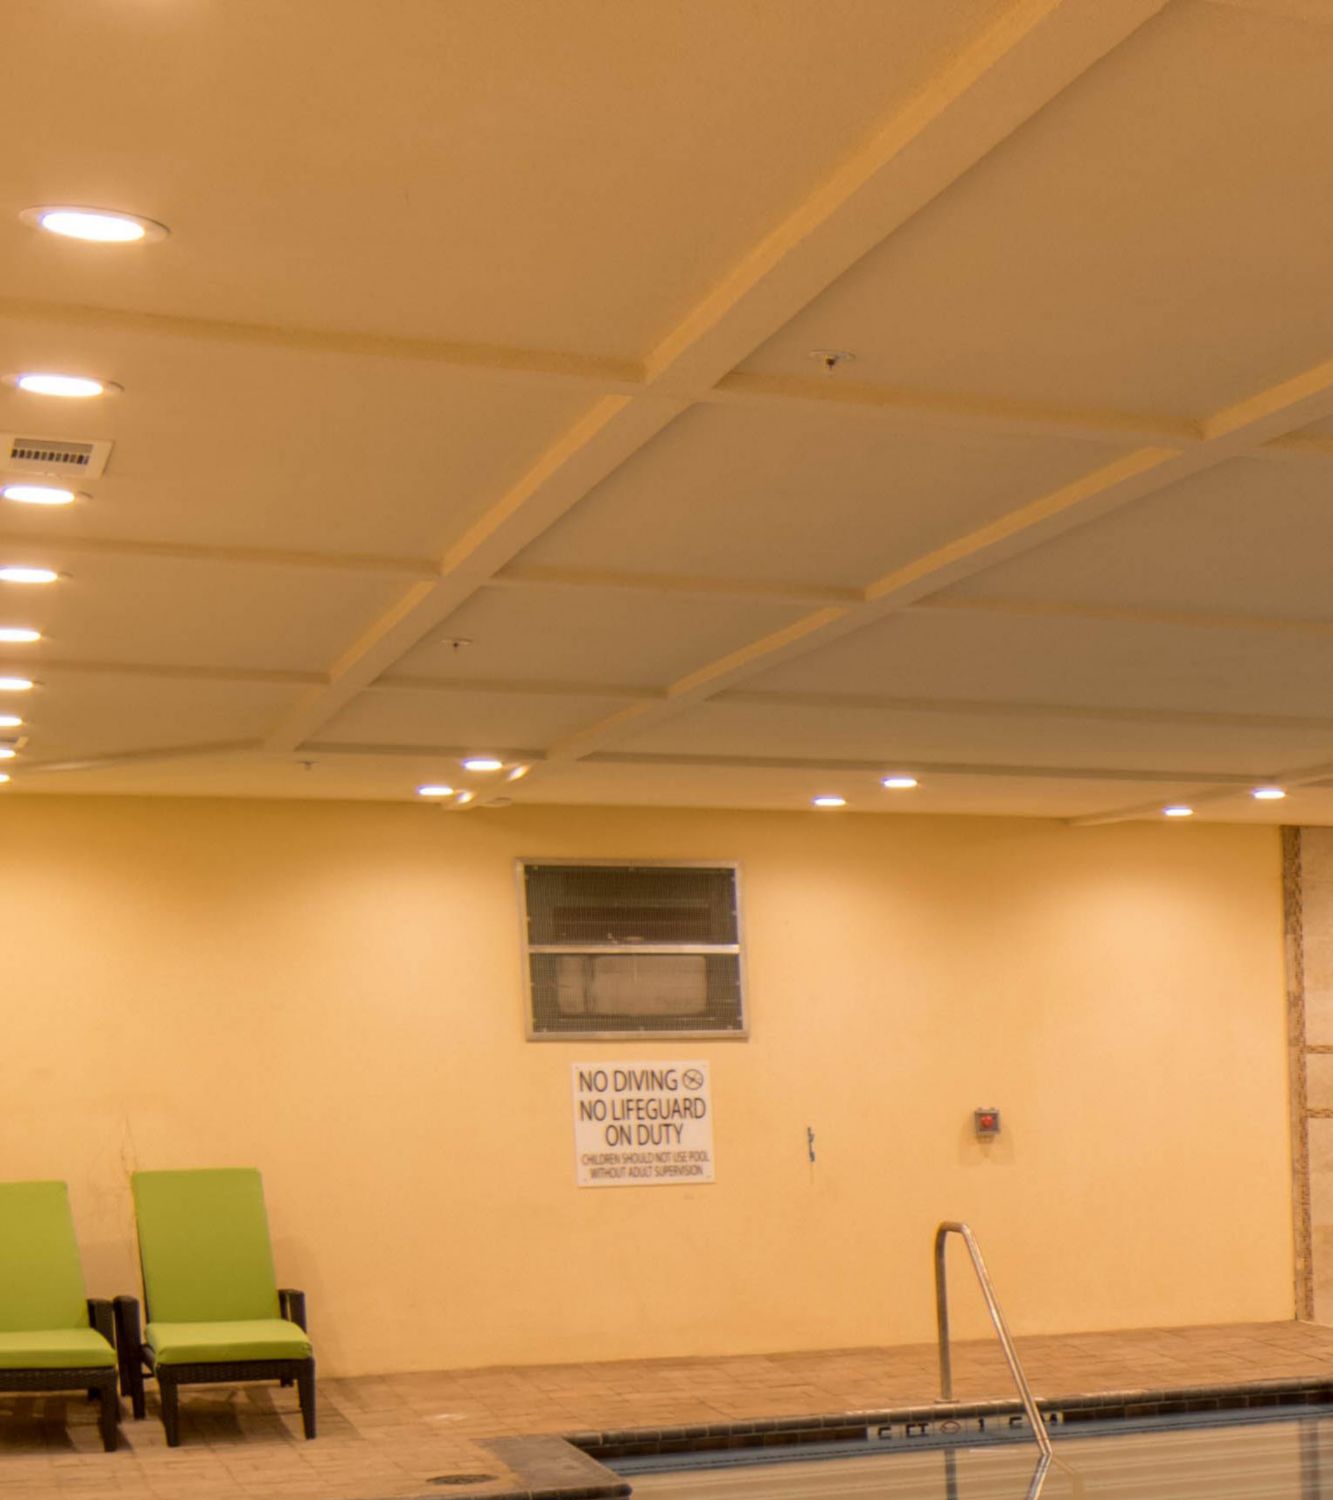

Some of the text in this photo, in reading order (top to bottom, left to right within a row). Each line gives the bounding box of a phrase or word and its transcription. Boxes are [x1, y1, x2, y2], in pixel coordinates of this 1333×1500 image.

[579, 1069, 678, 1092] NO DIVING
[580, 1098, 706, 1121] NO LIFEGUARD
[605, 1123, 684, 1147] ON DUTY
[581, 1150, 710, 1166] CHILDREN SHOULD NOT USE POOL
[589, 1165, 703, 1179] WITHOUT ADULT SUPERVISION
